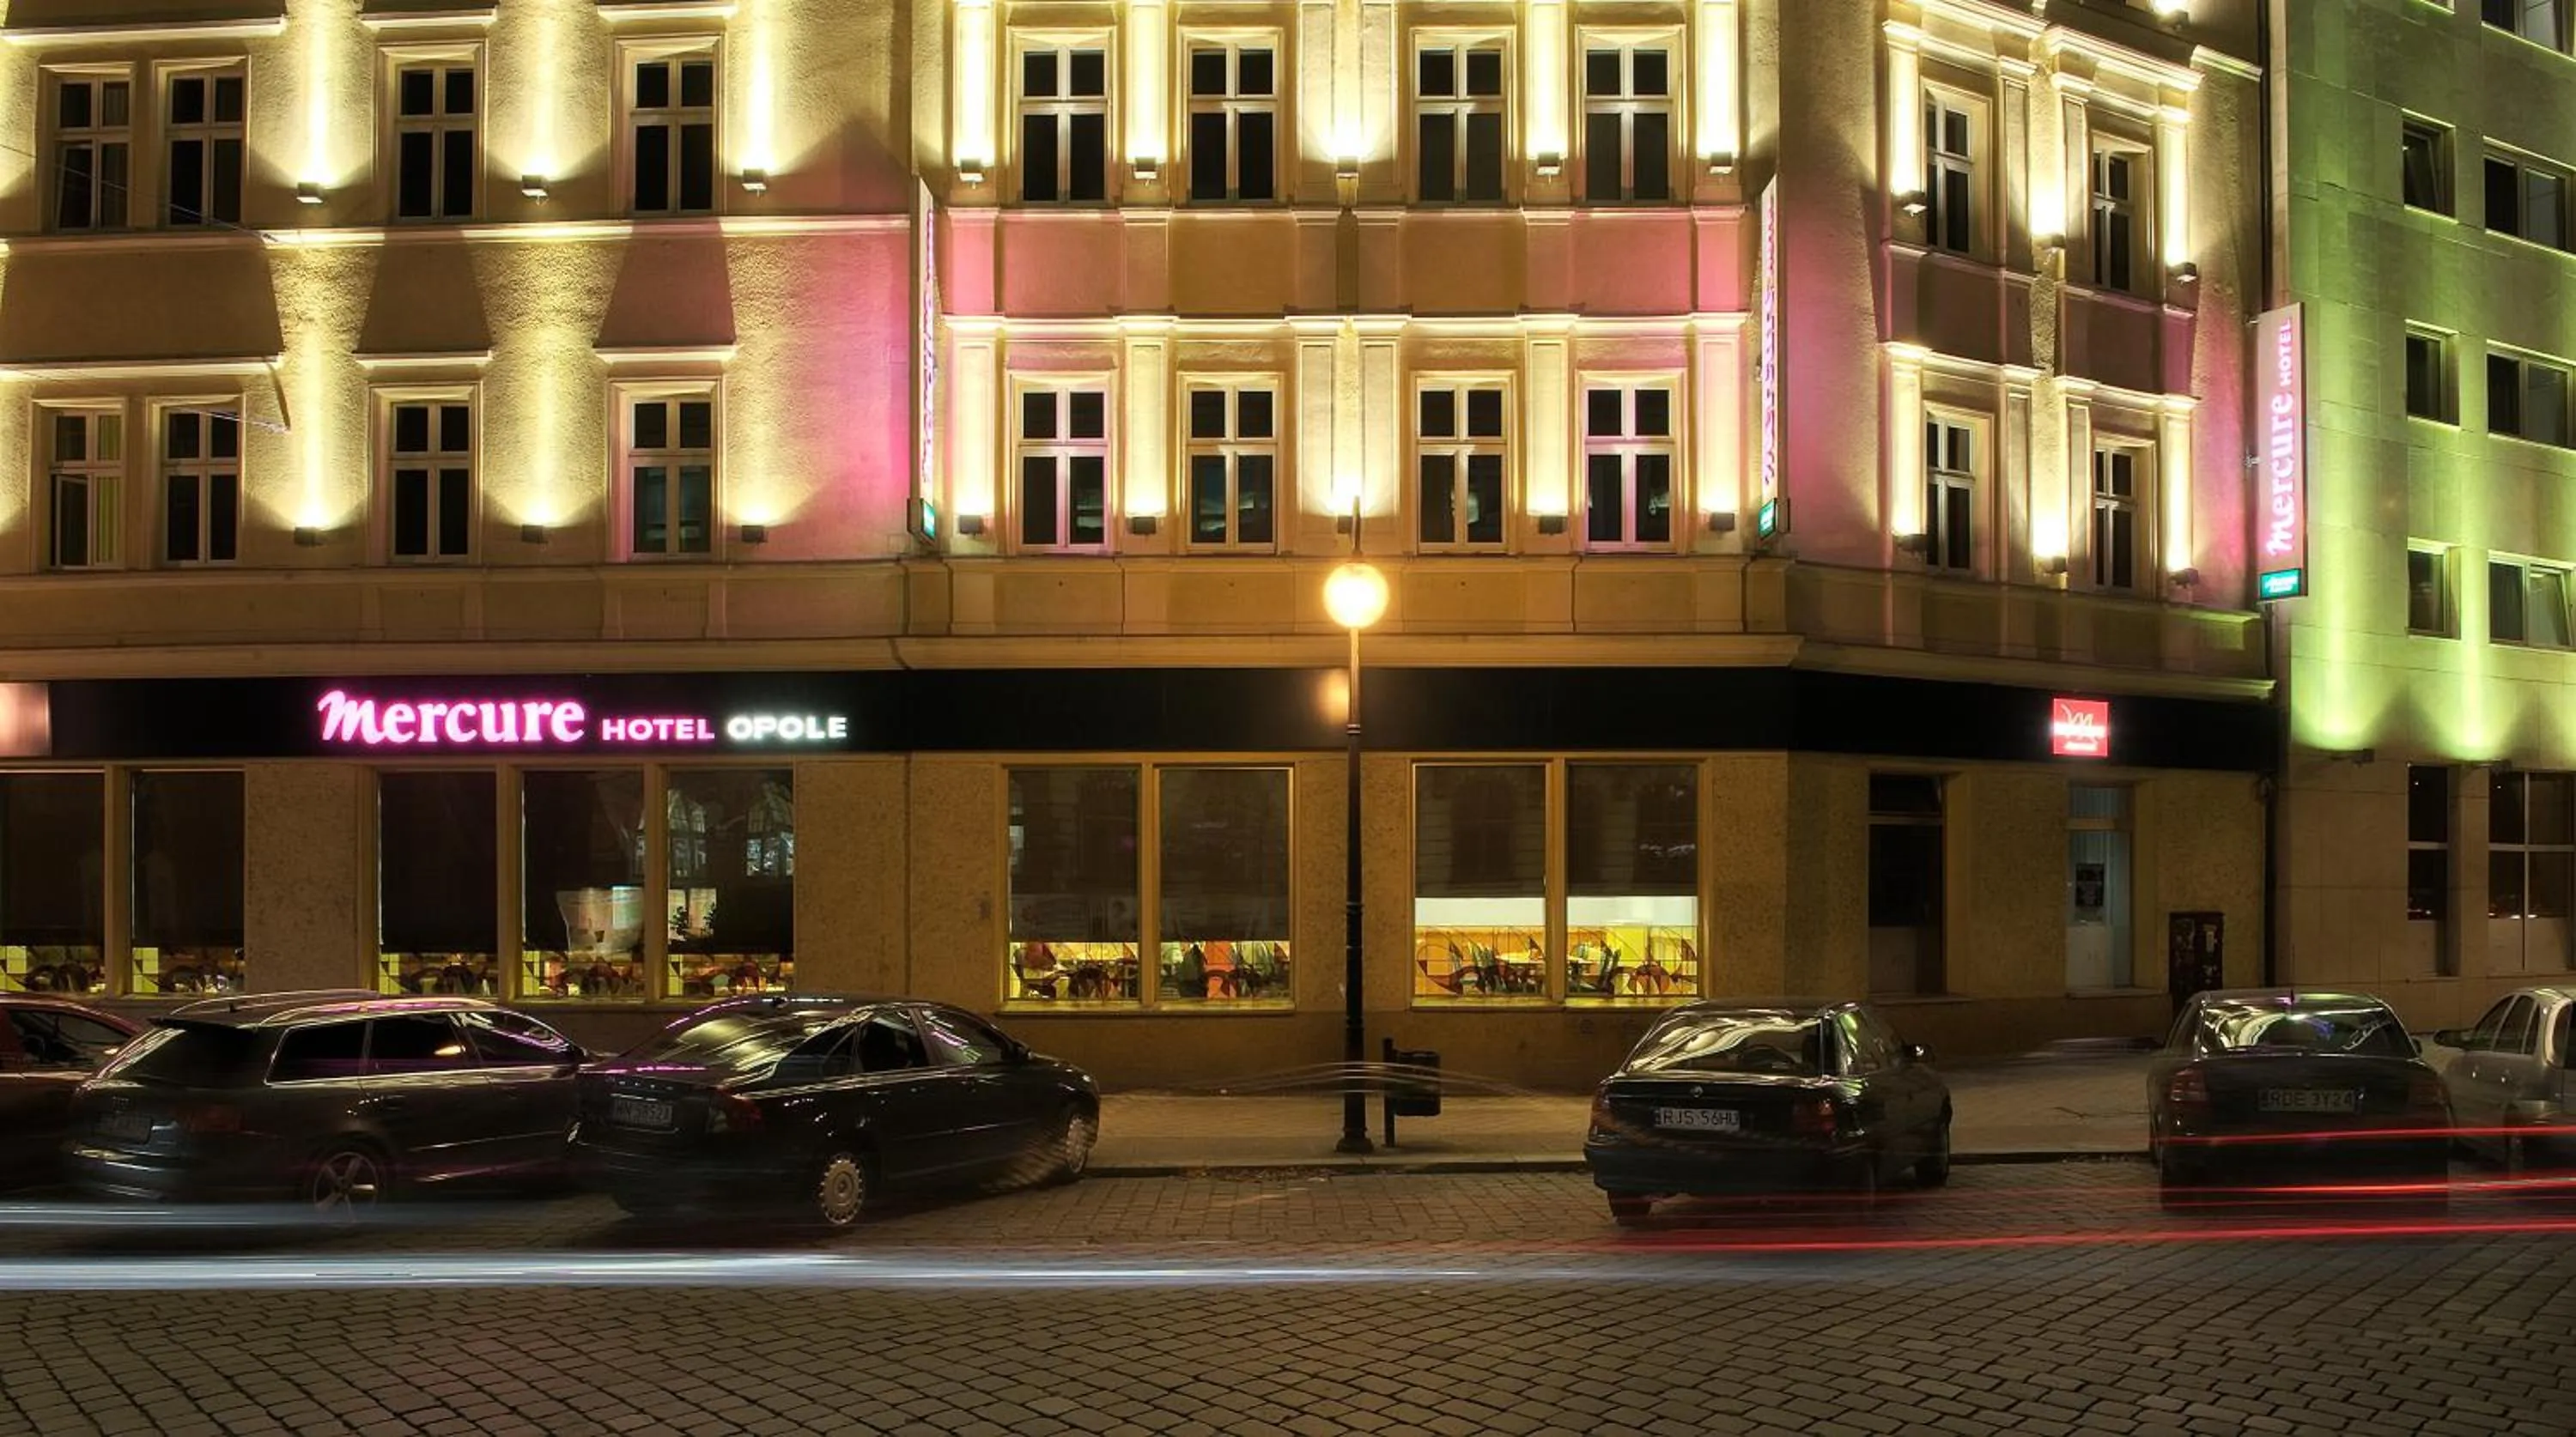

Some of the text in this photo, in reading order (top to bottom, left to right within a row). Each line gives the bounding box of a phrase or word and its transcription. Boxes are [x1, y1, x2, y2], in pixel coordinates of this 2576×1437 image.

[2278, 318, 2293, 386] HOTEL
[601, 718, 715, 741] HOTEL
[726, 714, 848, 740] OPOLE
[1662, 1110, 1739, 1126] RJS 56HU
